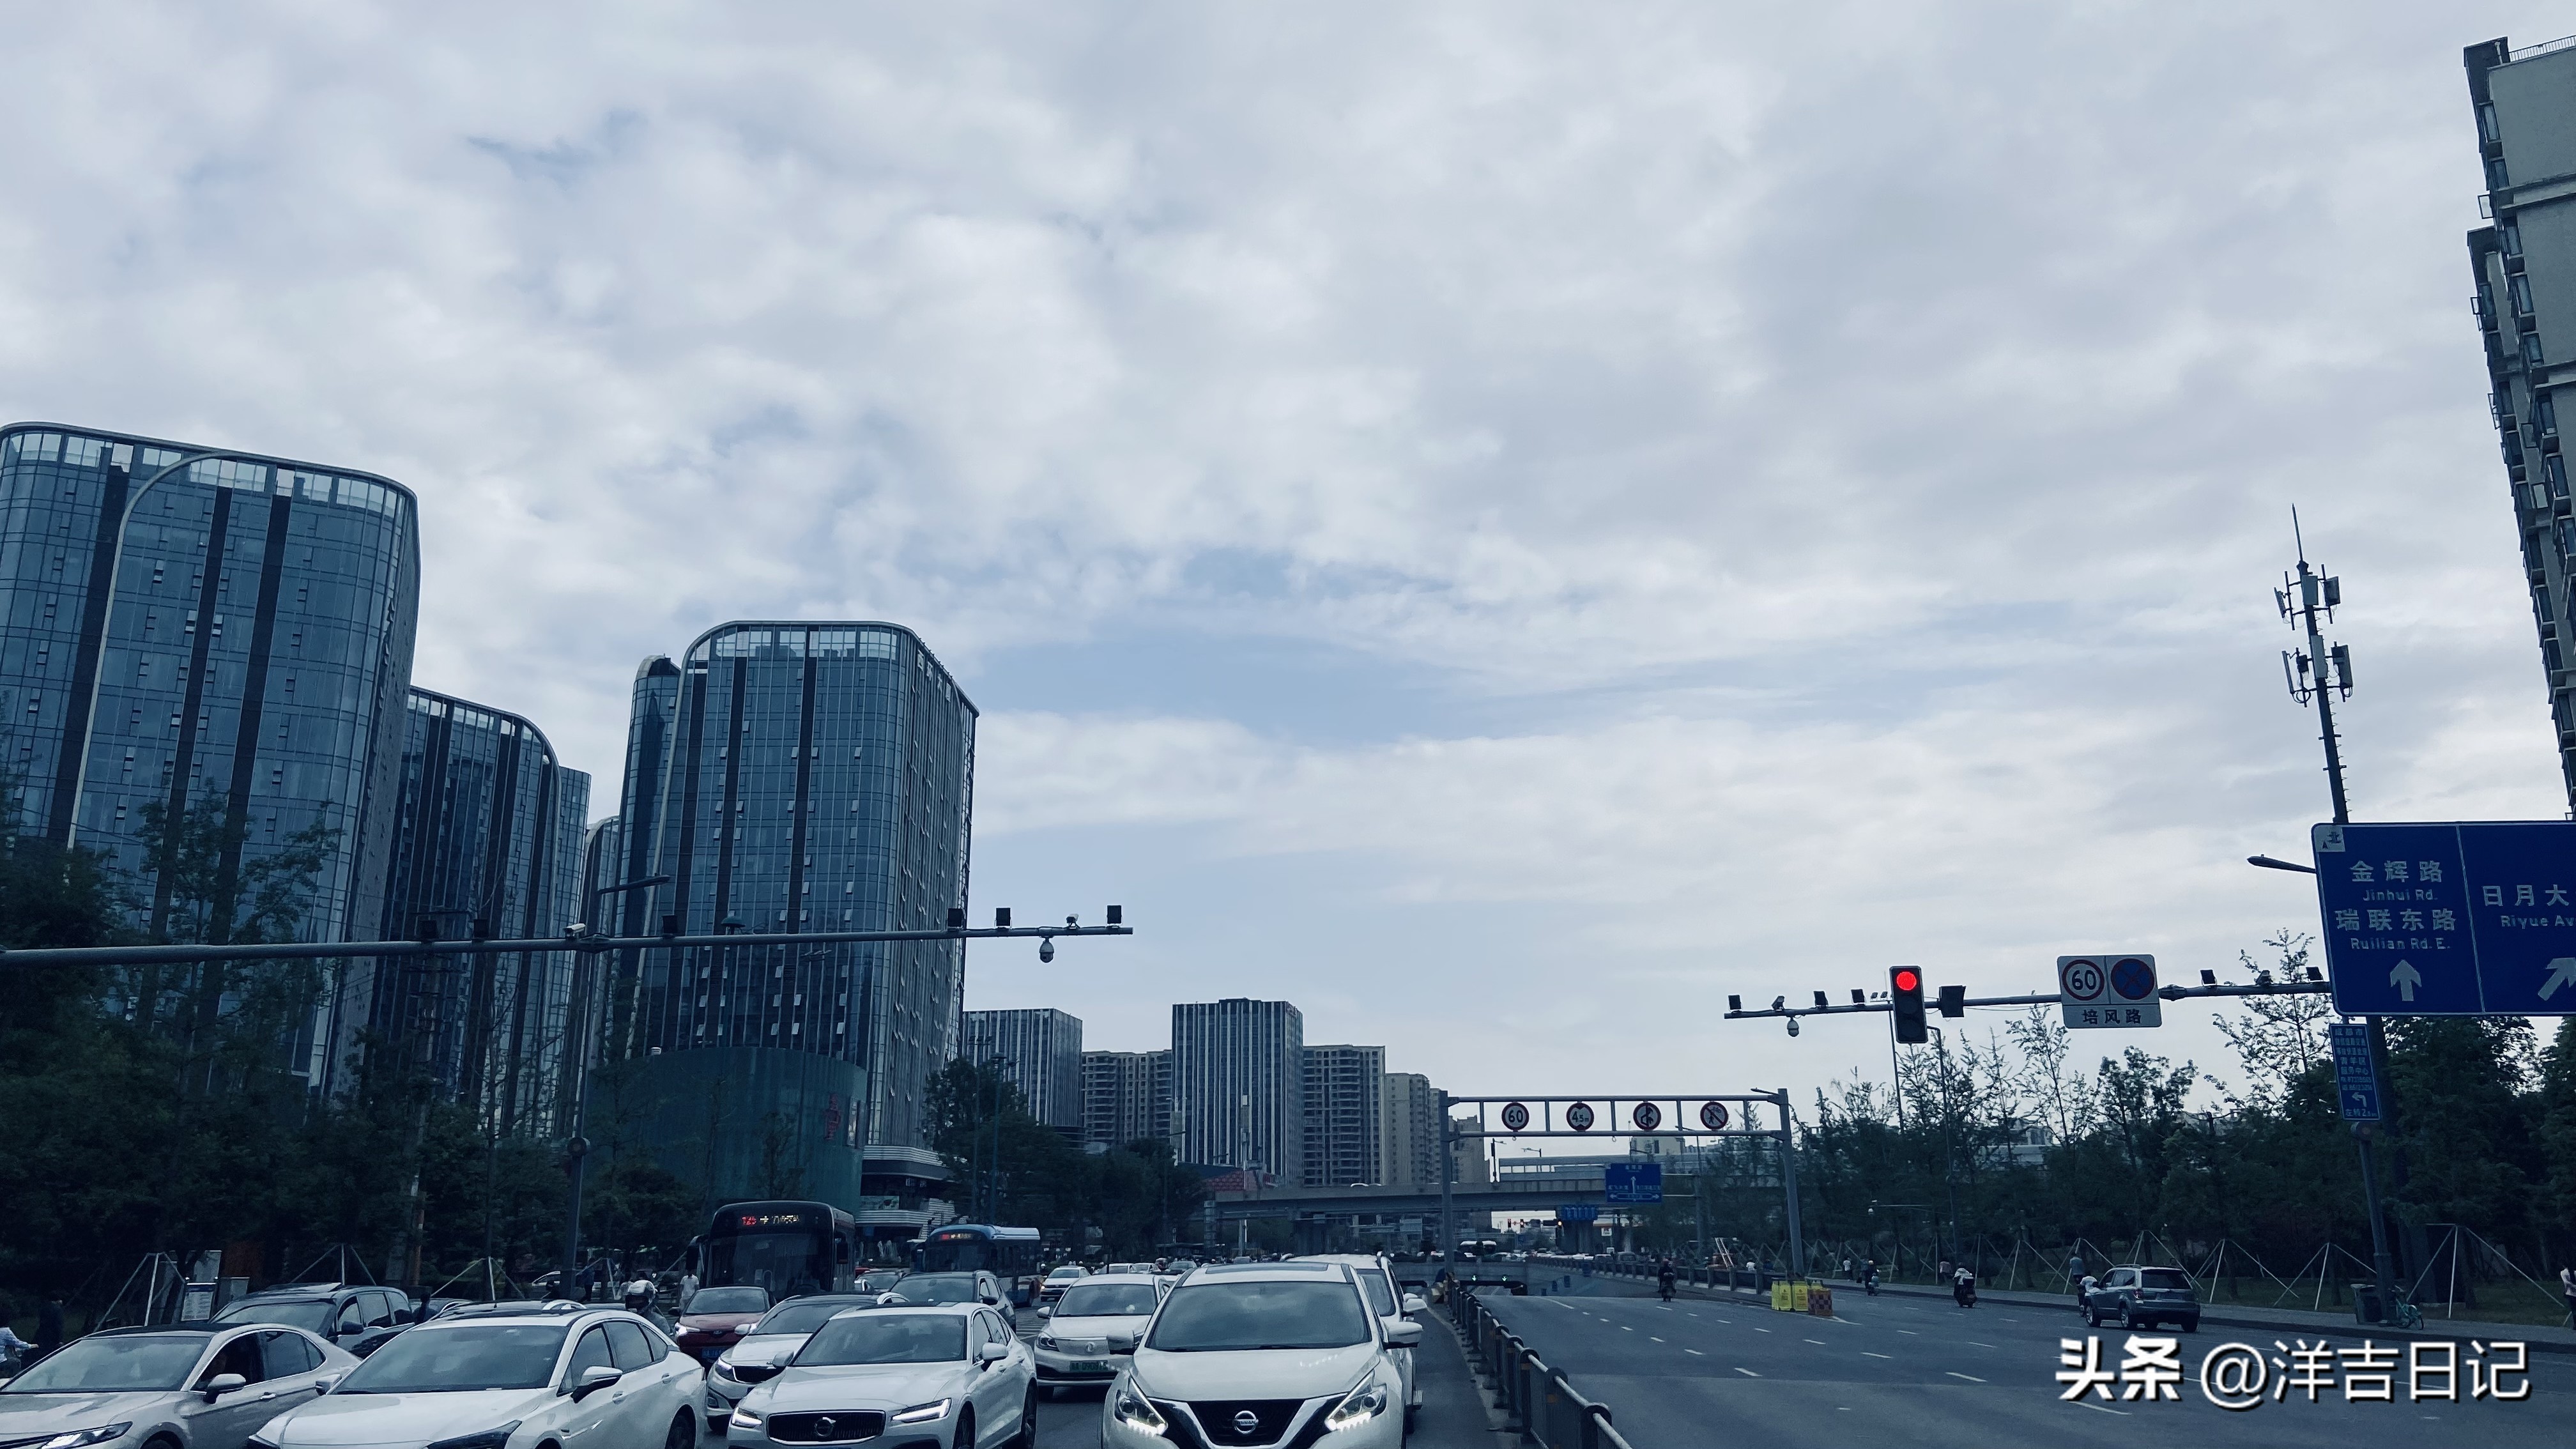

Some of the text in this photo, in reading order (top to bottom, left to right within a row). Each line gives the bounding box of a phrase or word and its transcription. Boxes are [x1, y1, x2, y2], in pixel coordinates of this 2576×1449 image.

[2350, 860, 2442, 883] 金辉路
[2363, 889, 2439, 901] Jinhui Rd.
[2481, 884, 2576, 907] 日月大
[2334, 908, 2457, 931] 瑞联东路
[2501, 915, 2576, 930] Riyue Av
[2350, 937, 2451, 950] Ruilian Rd. E.
[2072, 969, 2097, 990] 60
[2082, 1009, 2142, 1025] 培风路
[1508, 1110, 1523, 1123] 60
